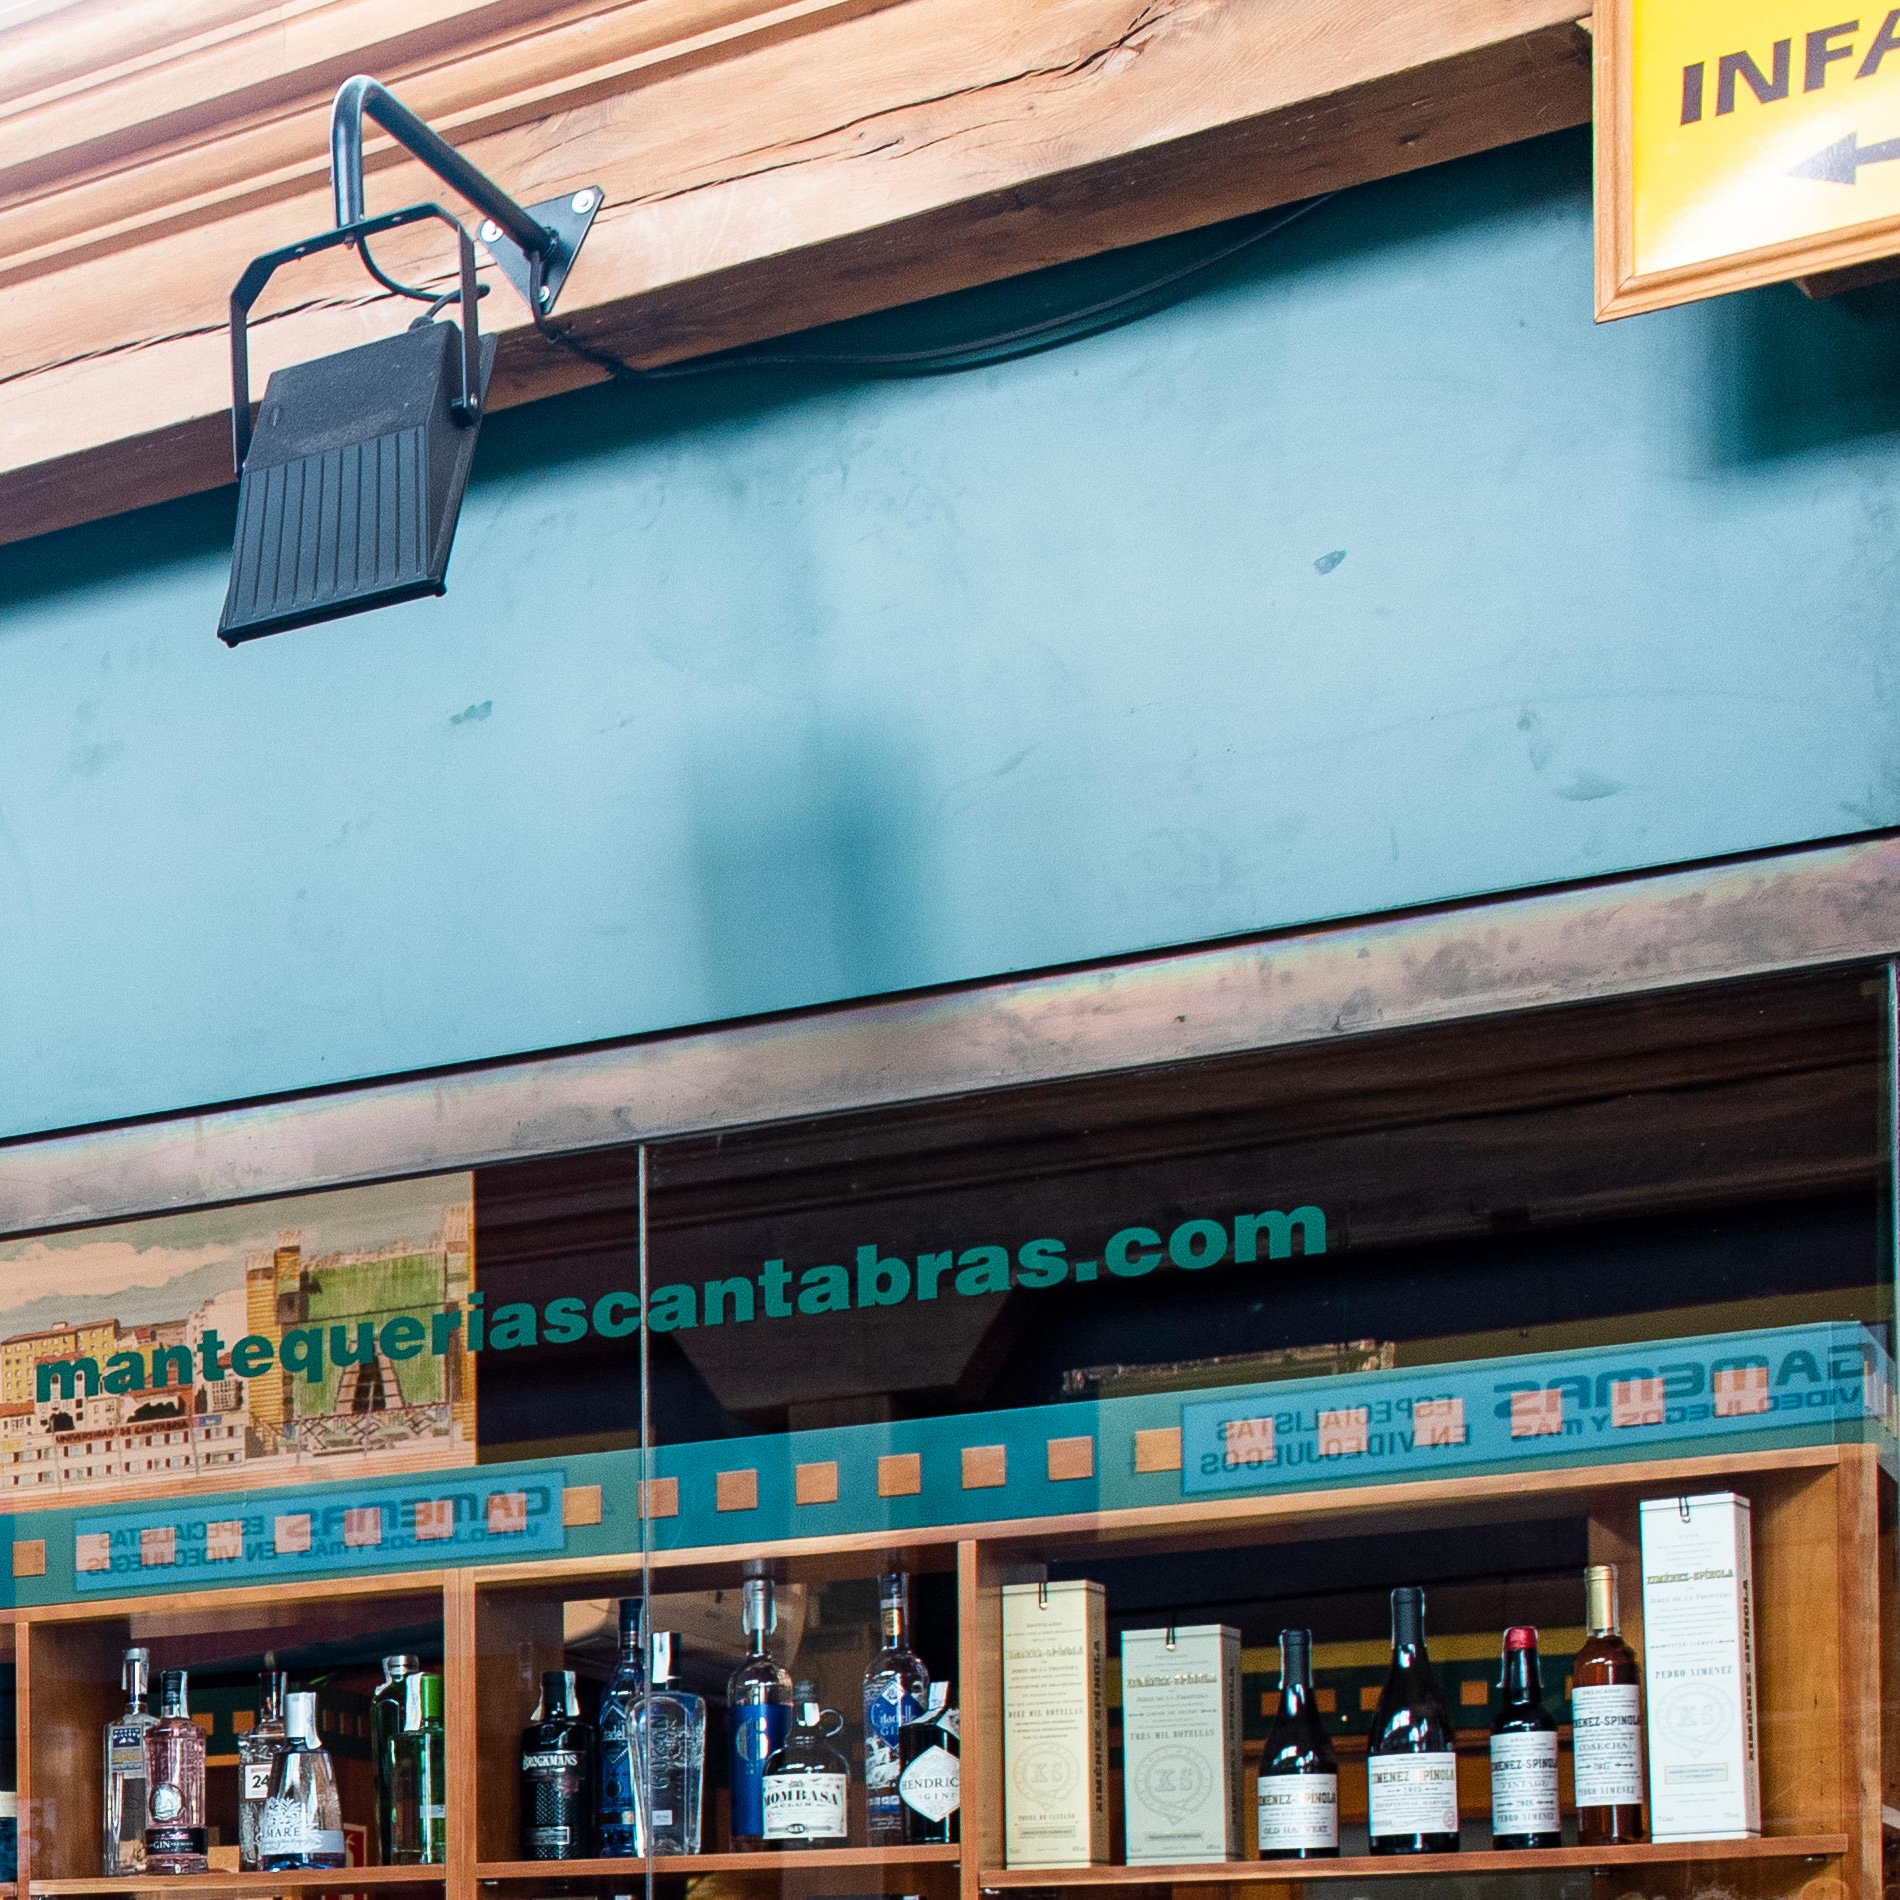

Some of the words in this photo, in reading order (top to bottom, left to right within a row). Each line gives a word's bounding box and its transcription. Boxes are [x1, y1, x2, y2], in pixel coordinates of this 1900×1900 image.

[35, 1203, 1329, 1403] mantequeriascantabras.com
[1154, 1729, 1170, 1740] MIL
[1577, 1740, 1629, 1751] COSECHA
[521, 1751, 578, 1769] BROCKMANS
[763, 1786, 839, 1808] MOMBASA
[265, 1827, 301, 1839] MARE
[152, 1840, 172, 1850] GIN
